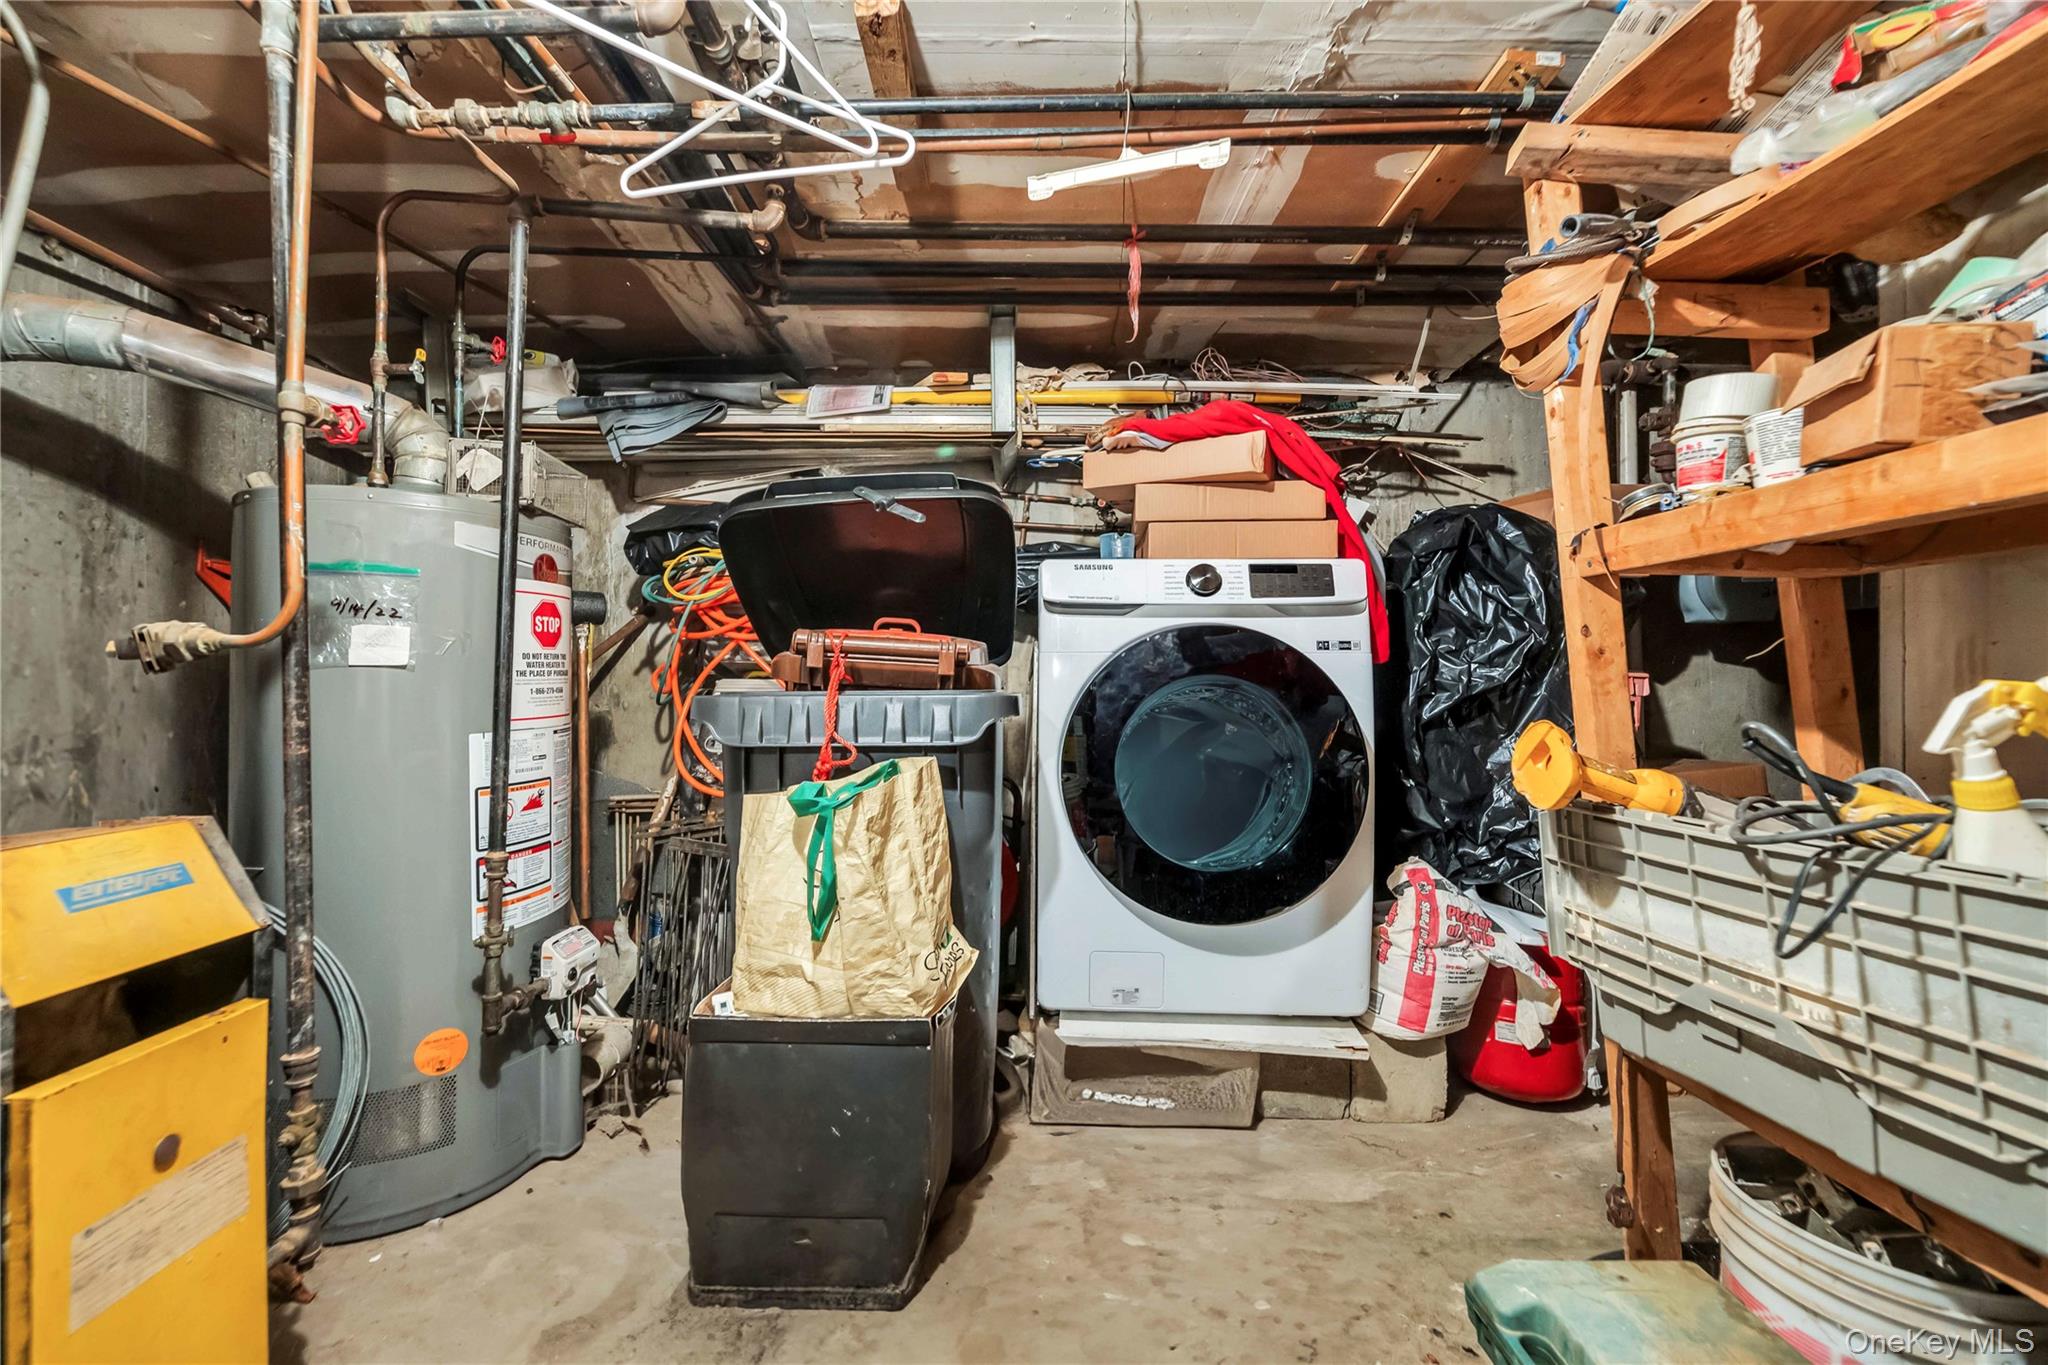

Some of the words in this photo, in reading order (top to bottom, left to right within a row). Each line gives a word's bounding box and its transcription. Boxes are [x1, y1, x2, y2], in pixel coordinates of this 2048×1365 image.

[1073, 563, 1114, 571] SAMSUNG
[534, 615, 561, 633] STOP
[521, 652, 531, 660] DO
[525, 661, 545, 669] WATER
[515, 669, 528, 677] THE
[1447, 924, 1461, 938] of
